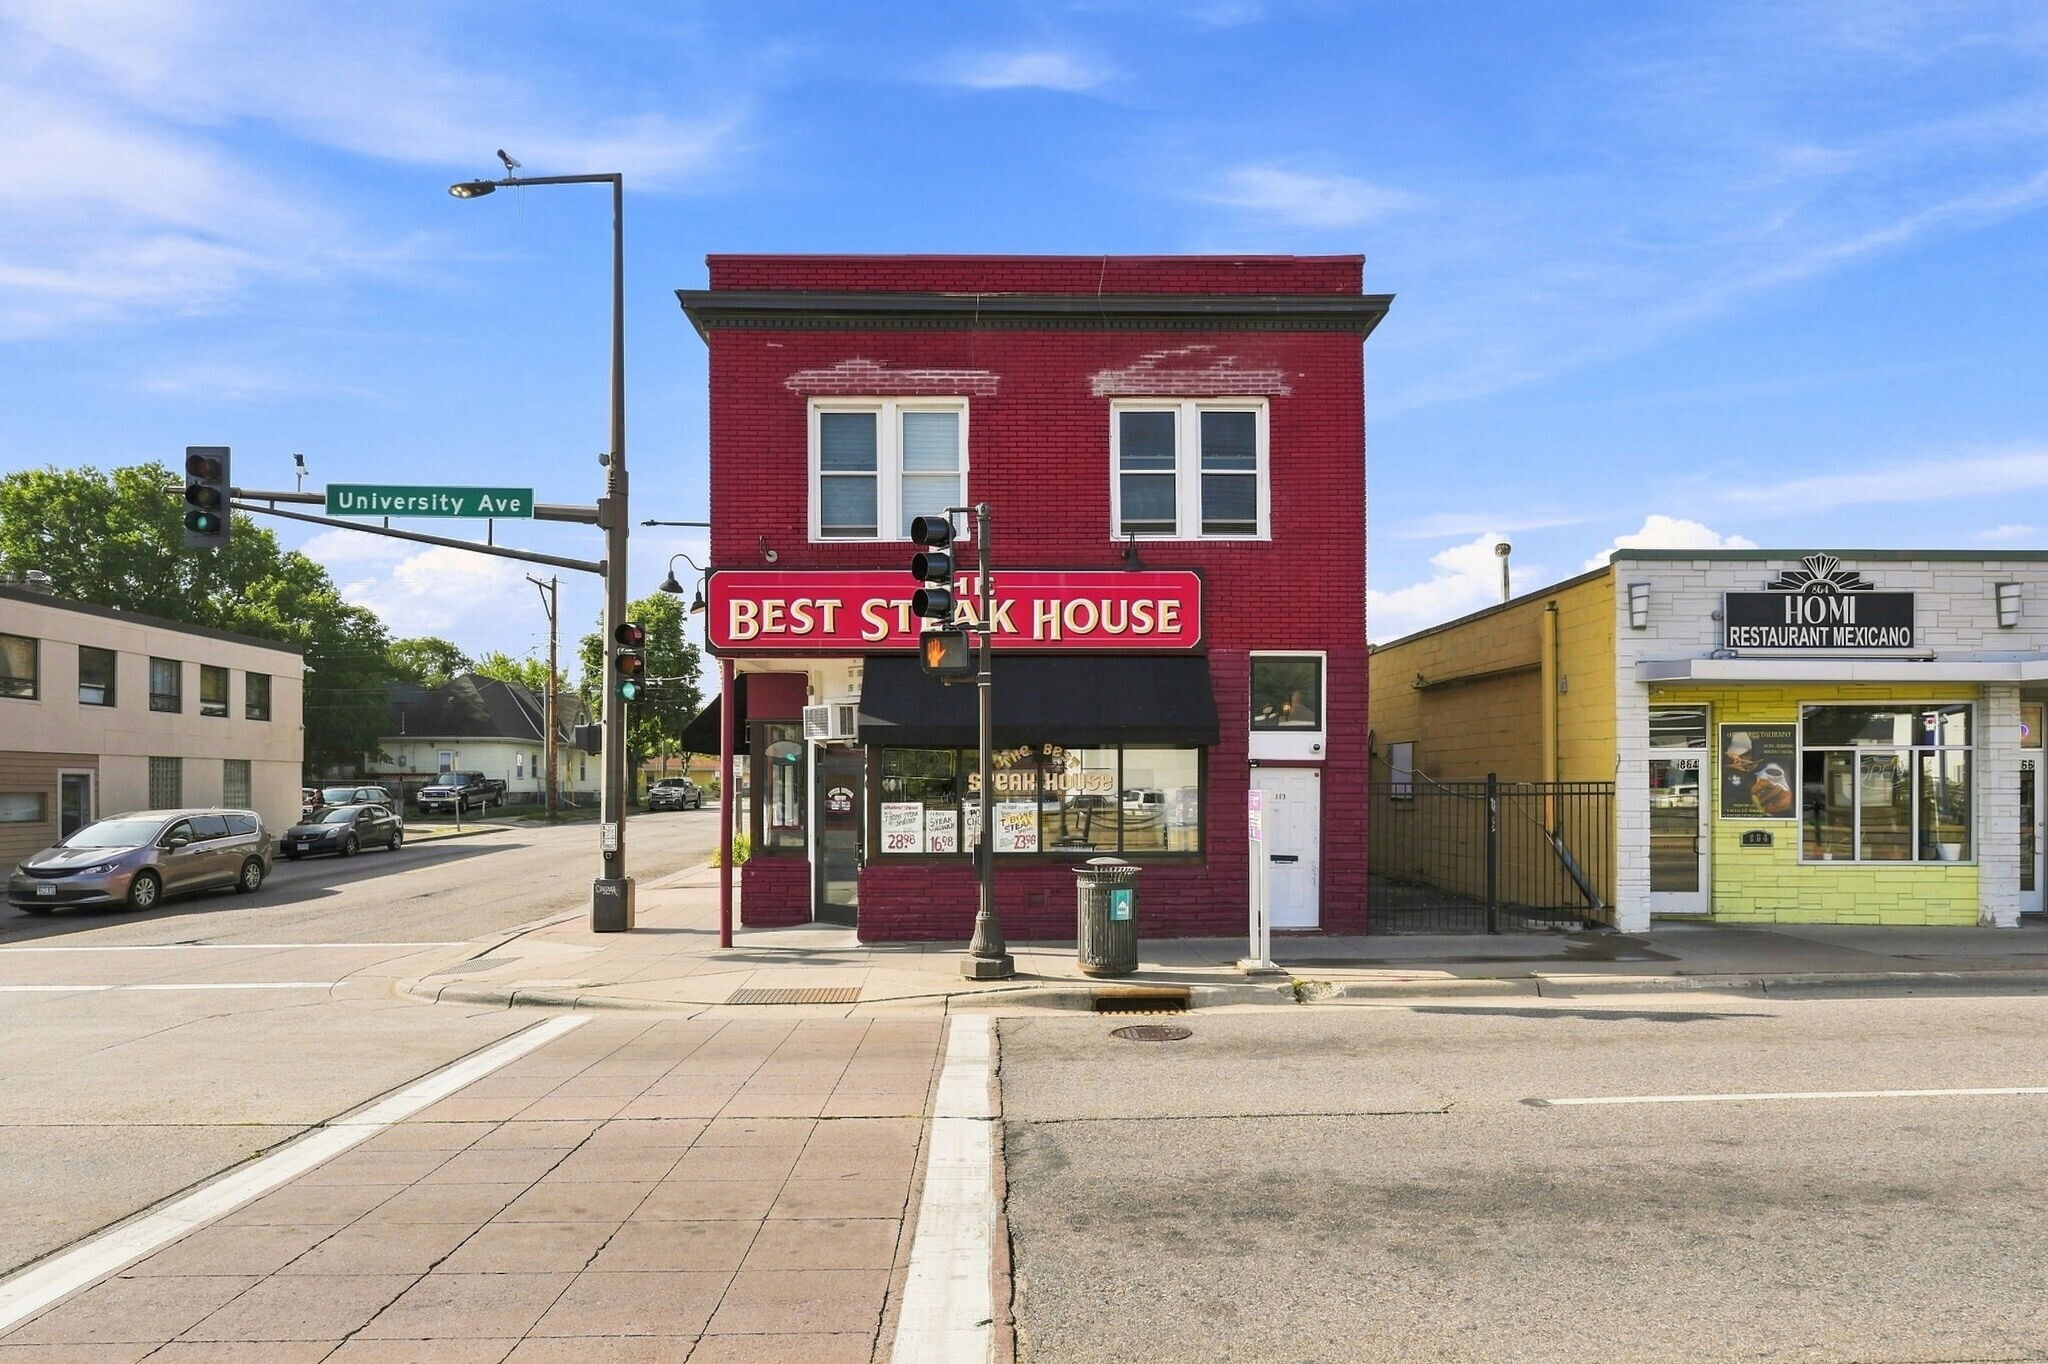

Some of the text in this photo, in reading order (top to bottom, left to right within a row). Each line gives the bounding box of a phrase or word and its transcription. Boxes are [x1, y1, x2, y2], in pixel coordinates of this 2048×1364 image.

[338, 491, 521, 515] University Ave
[1811, 582, 1829, 594] 864
[728, 597, 842, 640] BEST
[1032, 597, 1183, 641] HOUSE
[1785, 595, 1855, 624] HOMI
[1729, 626, 1911, 647] RESTAURANT MEXICANO
[1680, 759, 1699, 769] 864
[2021, 760, 2035, 770] 66
